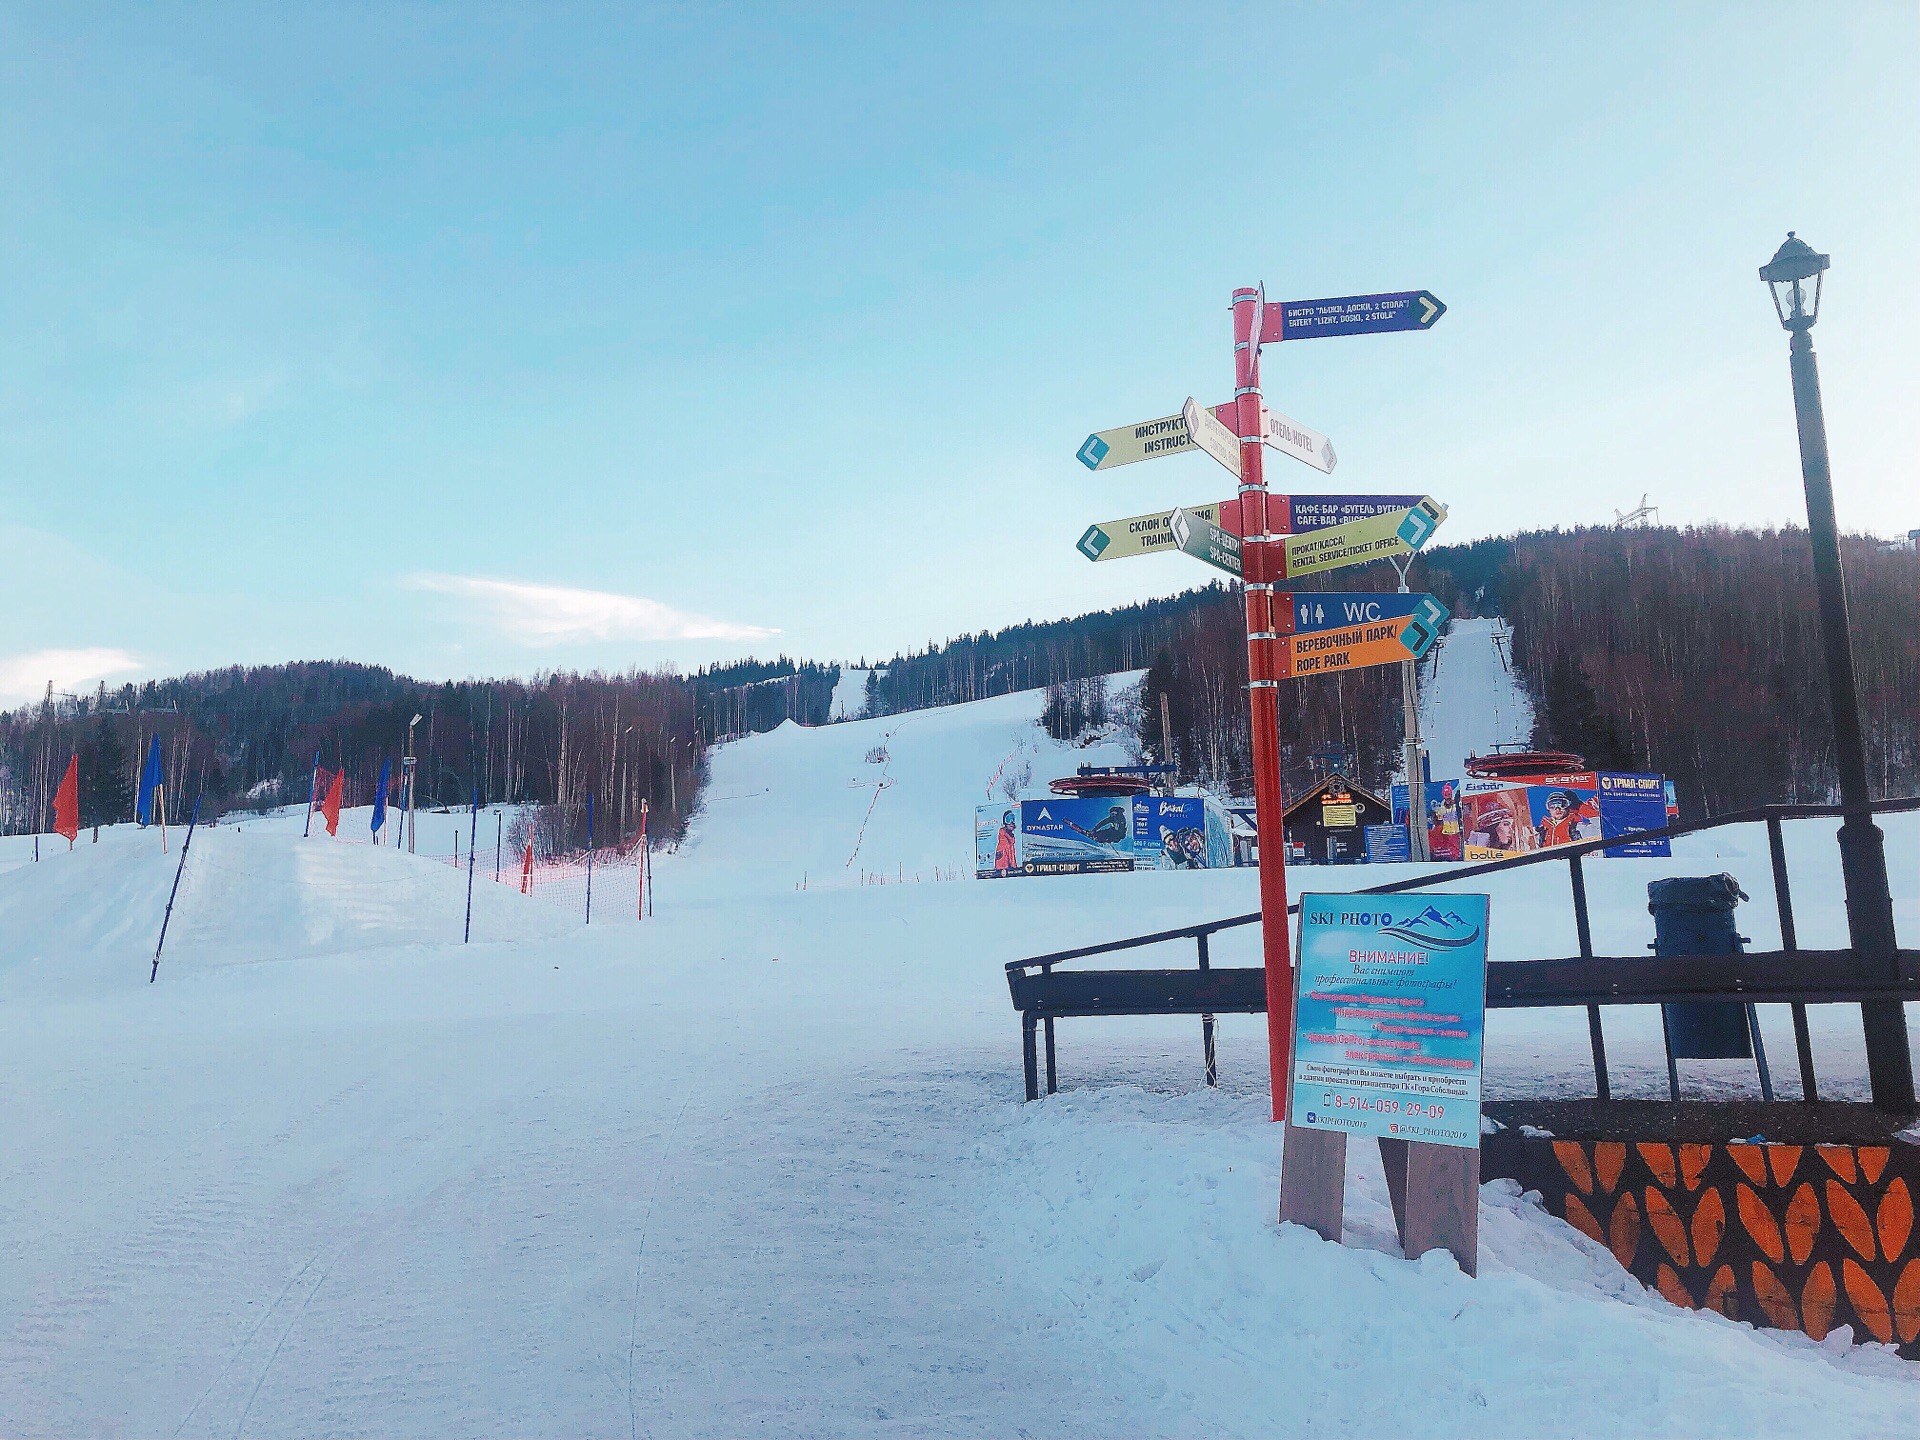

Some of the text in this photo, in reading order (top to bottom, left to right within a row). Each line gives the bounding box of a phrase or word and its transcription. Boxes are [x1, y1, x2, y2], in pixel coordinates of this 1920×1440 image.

[1288, 307, 1314, 317] БИСТРО
[1346, 303, 1372, 313] ДОСКИ,
[1340, 314, 1363, 323] DOSKI,
[1365, 312, 1370, 320] 2
[1371, 311, 1396, 320] STOLA"
[1135, 417, 1186, 439] ИНСТРУКТ
[1270, 418, 1314, 453] ОТЕЛЬ/HOTEL
[1144, 433, 1191, 454] INSTRUCT
[1295, 504, 1339, 514] КАФЕ-БАР
[1341, 504, 1375, 514] «БУГЕЛЬ
[1129, 518, 1160, 533] СКЛОН
[1297, 515, 1337, 525] CAFE-BAR
[1291, 535, 1346, 556] ПРОКАТ/КАССА/
[1292, 536, 1399, 569] RENTAL SERVICE/TICKET OFFICE
[1342, 601, 1382, 622] WC
[1296, 624, 1398, 654] ВЕРЕВОЧНЫЙ ПАРК/
[1296, 651, 1350, 672] ROPE PARK
[1465, 782, 1504, 791] Eisbär
[1612, 777, 1660, 789] ТРИАЛ-СПОРТ
[1026, 824, 1064, 832] DYNASTAR
[1470, 850, 1504, 859] bollé
[1036, 863, 1080, 872] ТРИАЛ-СПОРТ
[1309, 912, 1393, 926] SKI PHOTO
[1349, 949, 1429, 966] ВНИМАНИЕ!
[1353, 964, 1415, 977] Вас снимают
[1314, 974, 1457, 991] профессиональные фотографы!
[1394, 1072, 1421, 1082] выбрать
[1335, 1094, 1445, 1119] 8-914-059-29-09
[1399, 1124, 1468, 1140] @SKI_PHOTO2019
